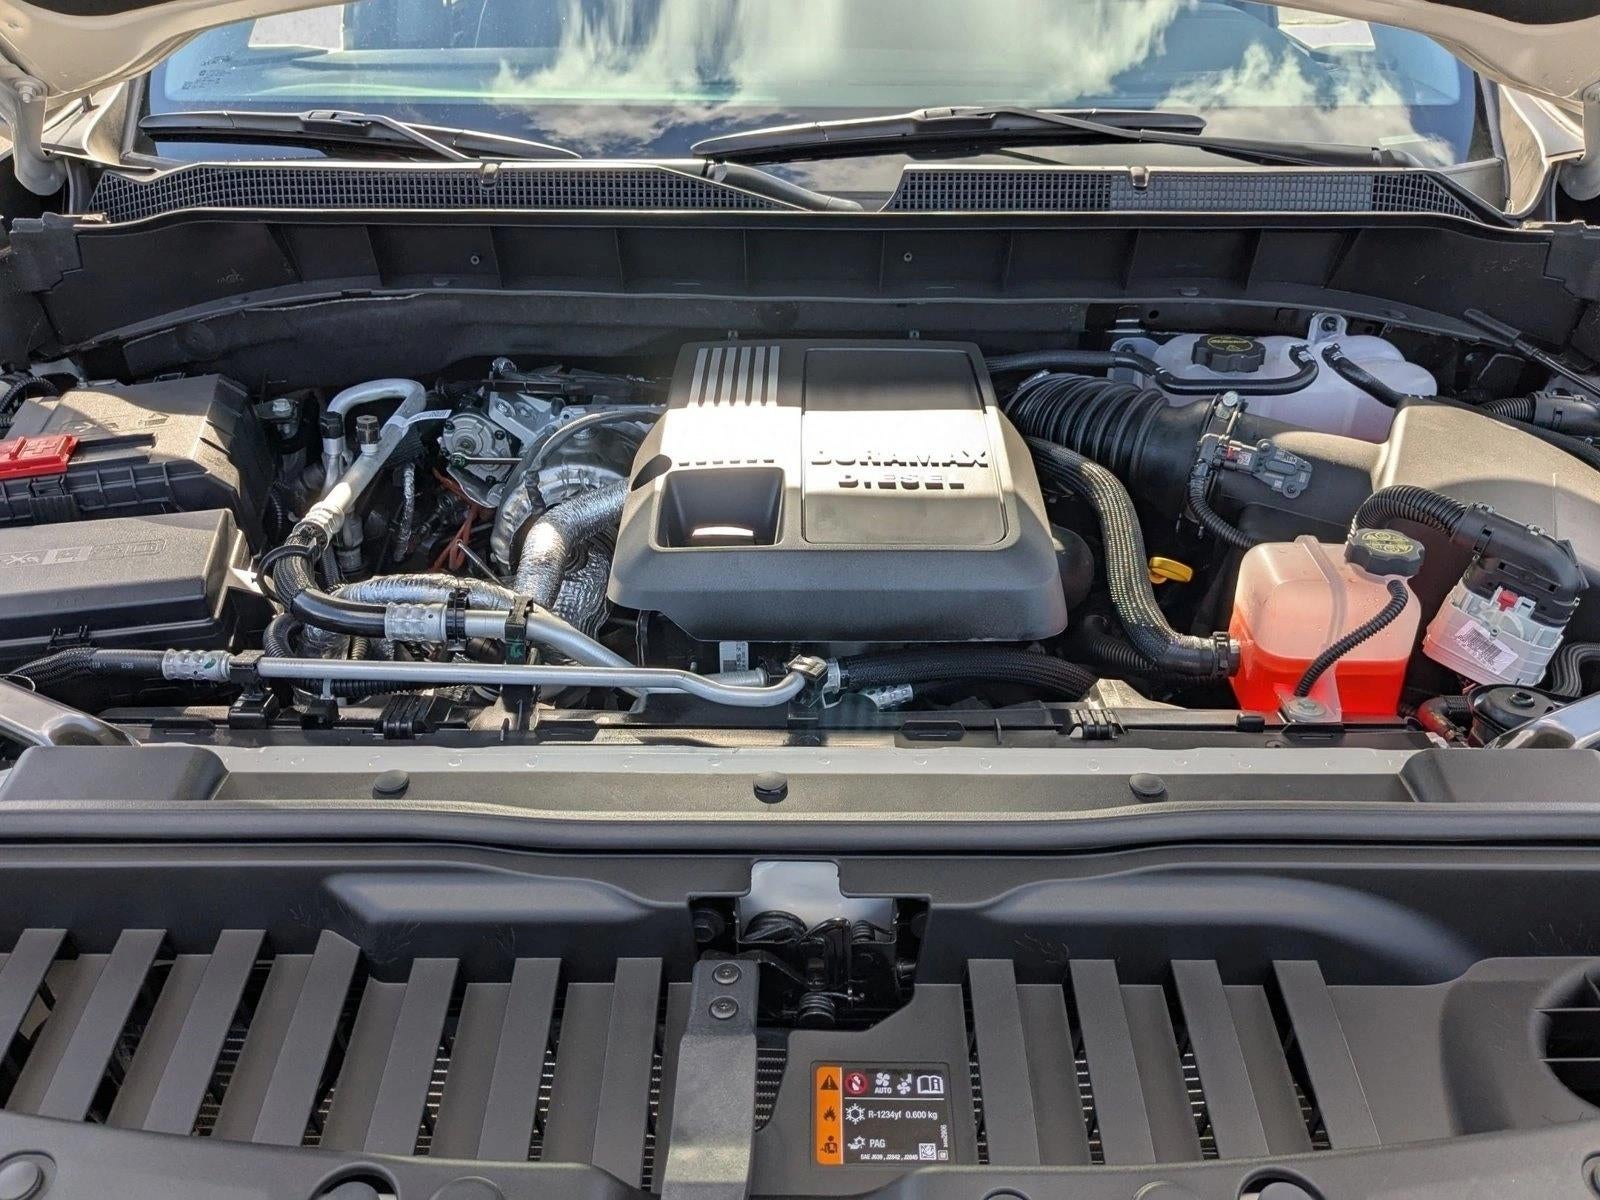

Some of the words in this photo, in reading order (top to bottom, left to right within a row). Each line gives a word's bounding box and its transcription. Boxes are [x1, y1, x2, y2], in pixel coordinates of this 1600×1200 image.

[811, 449, 989, 468] DURAMAX
[838, 473, 965, 491] DIESEL
[868, 1110, 902, 1119] R-1234yf
[905, 1110, 927, 1119] 0.600
[927, 1111, 938, 1120] kg
[869, 1139, 886, 1148] PAG
